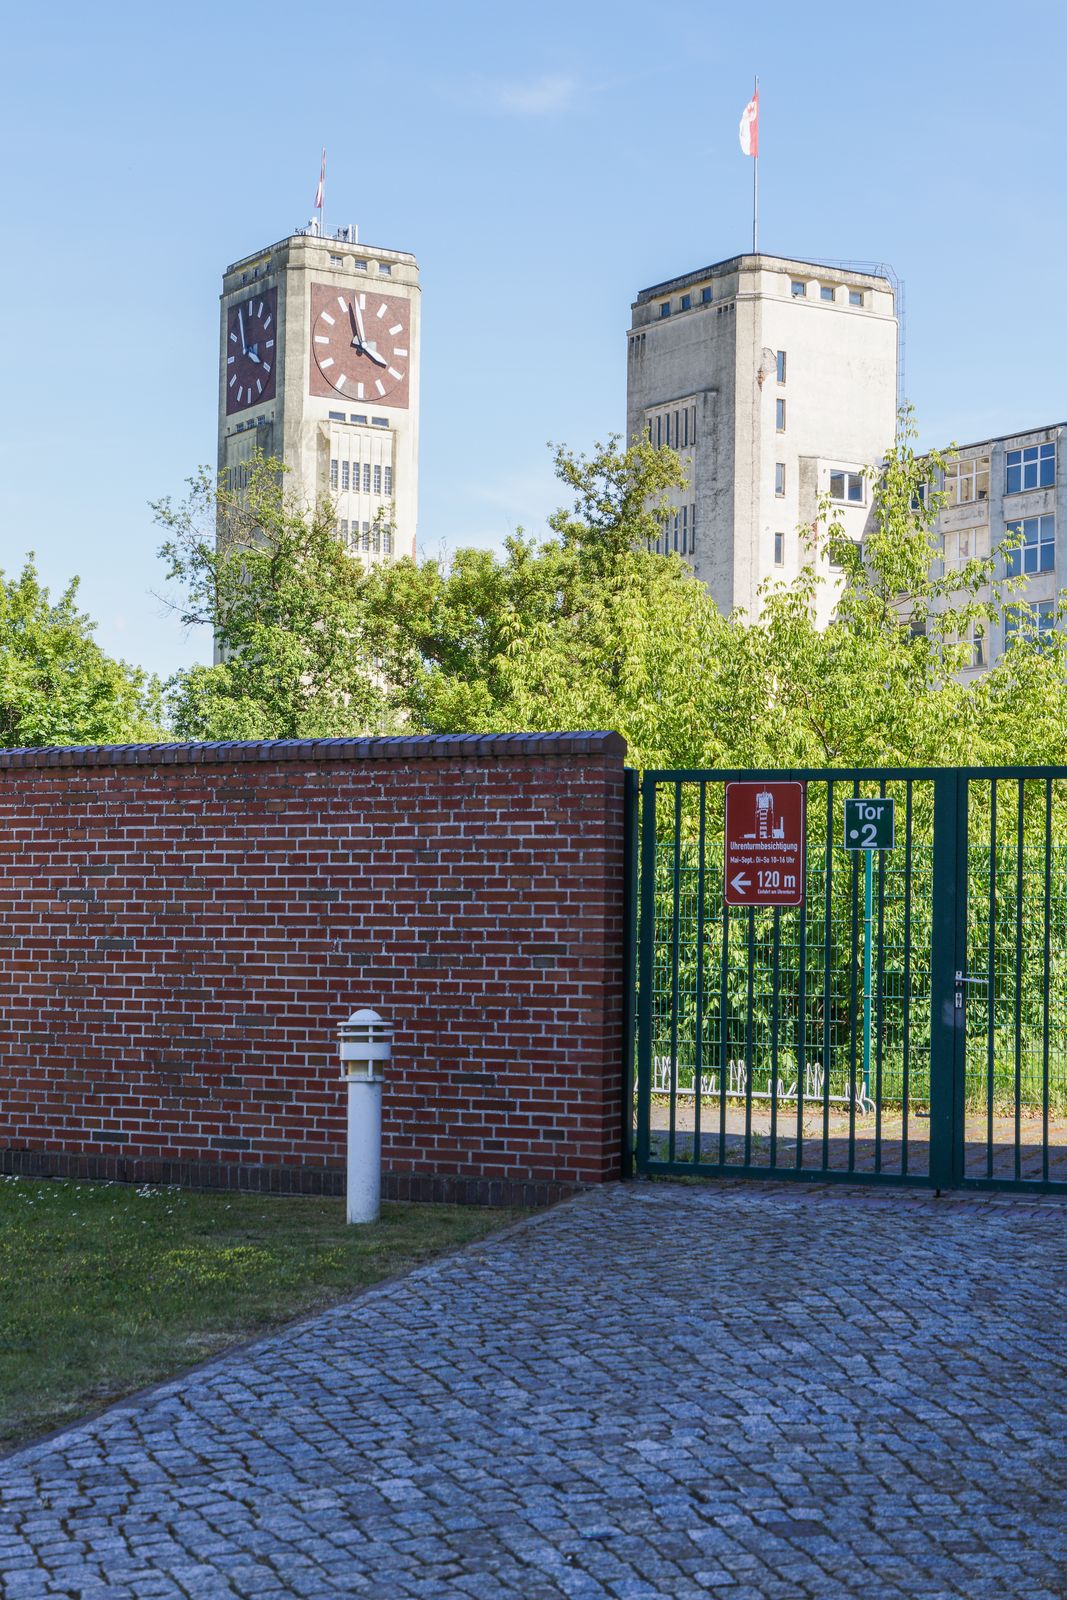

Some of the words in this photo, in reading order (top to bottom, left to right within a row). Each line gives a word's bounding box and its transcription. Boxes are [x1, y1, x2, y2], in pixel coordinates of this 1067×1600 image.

[855, 803, 884, 820] Tor
[730, 841, 798, 852] Uhrenturmbesichtigung
[757, 871, 780, 887] 120
[783, 875, 796, 888] m
